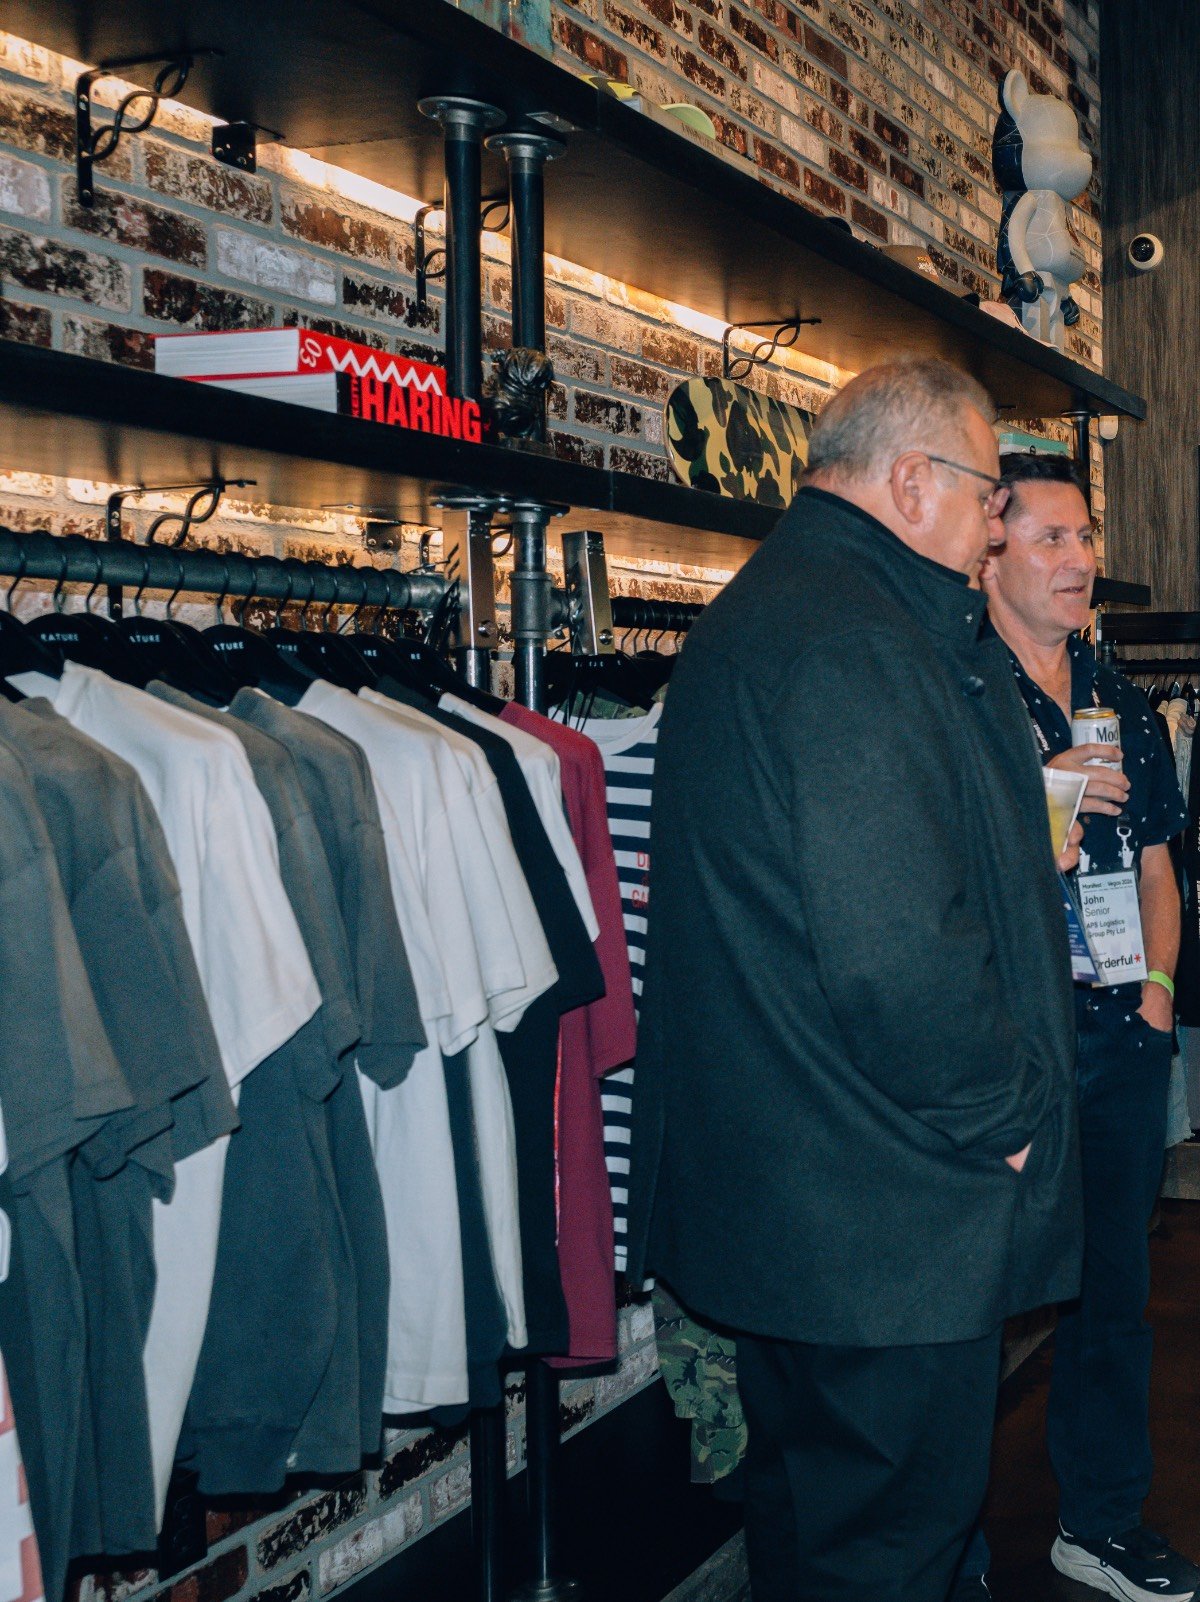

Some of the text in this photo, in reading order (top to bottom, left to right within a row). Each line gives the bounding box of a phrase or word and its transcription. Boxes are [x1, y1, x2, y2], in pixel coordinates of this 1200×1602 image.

[361, 376, 482, 444] HARING
[1084, 895, 1105, 905] John
[1085, 907, 1110, 917] Senior
